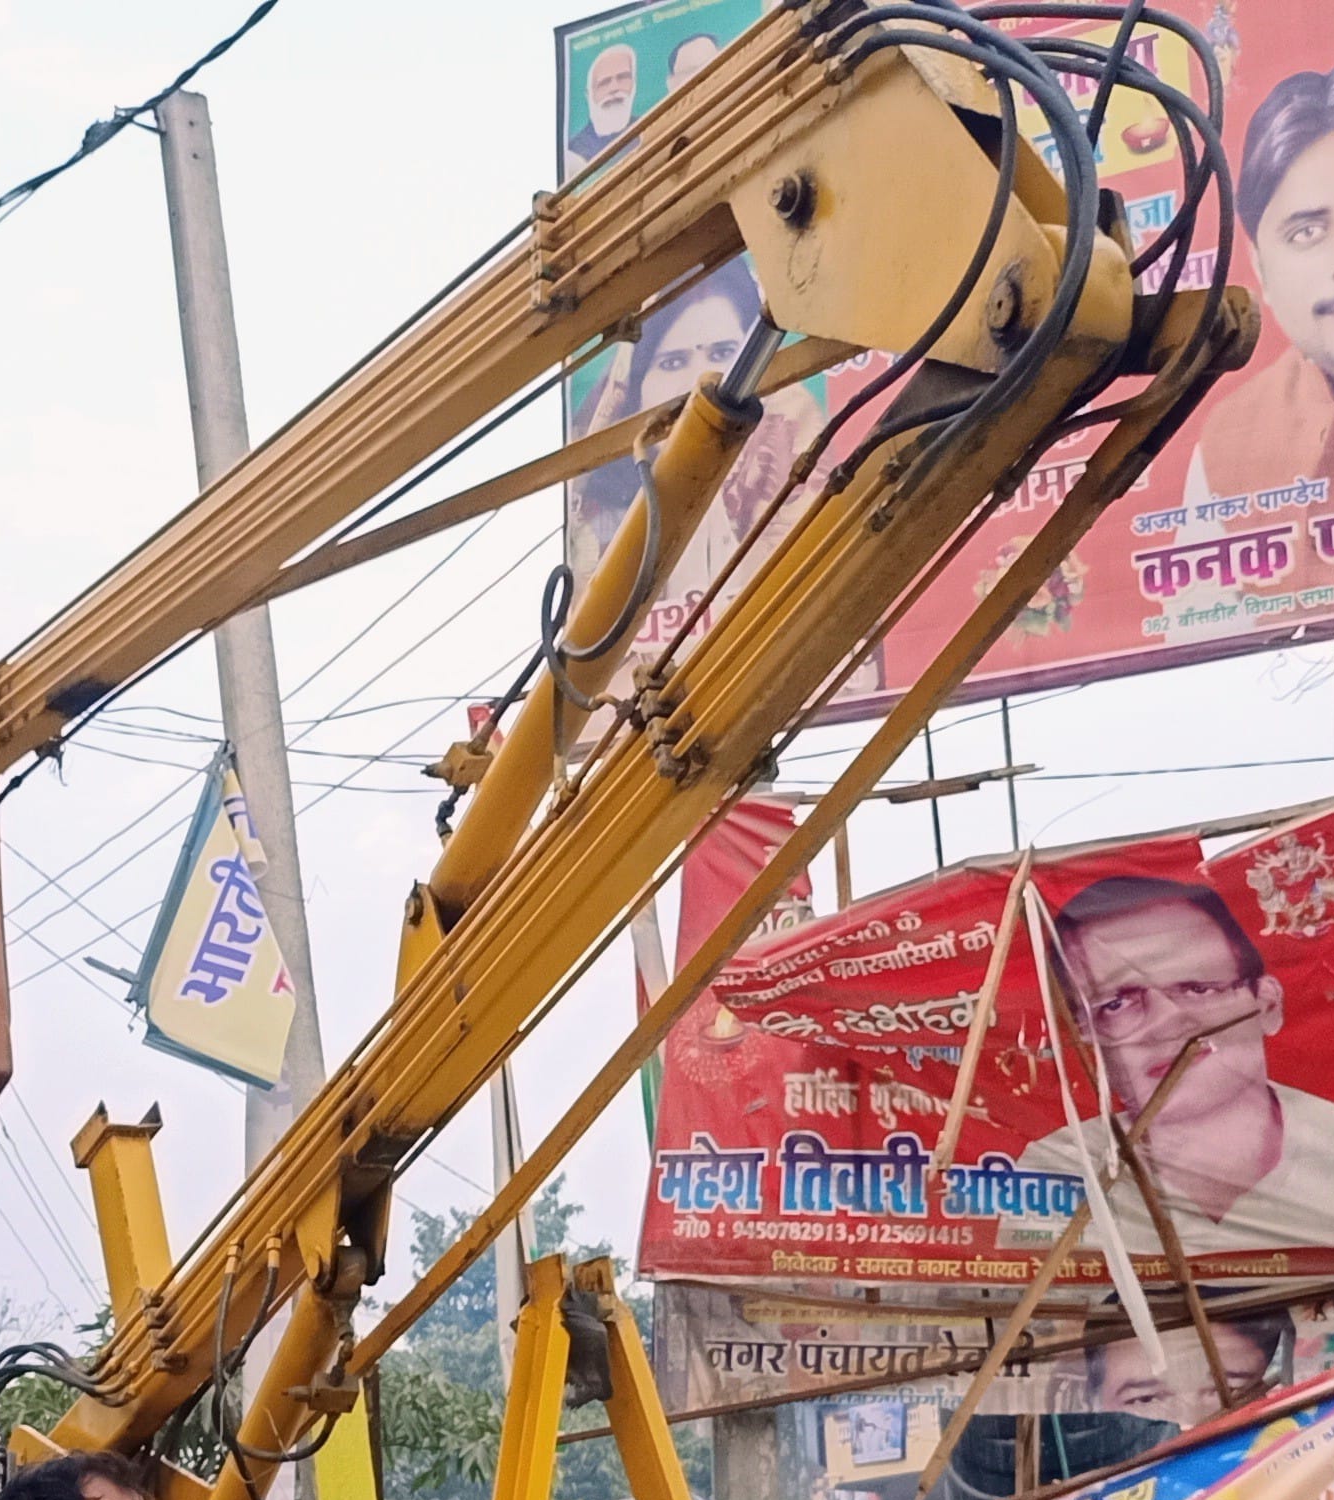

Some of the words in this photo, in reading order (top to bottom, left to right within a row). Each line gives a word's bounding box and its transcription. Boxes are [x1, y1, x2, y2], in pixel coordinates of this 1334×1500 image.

[1134, 508, 1187, 535] अजय
[1196, 496, 1248, 522] शंकर
[1258, 480, 1327, 509] पाण्डेय
[1136, 526, 1292, 597] कनक
[826, 931, 957, 979] नगरवासियों
[960, 921, 998, 951] को
[783, 1067, 860, 1118] हार्दिक
[659, 1136, 765, 1212] महेश
[780, 1133, 930, 1213] तिवारी
[944, 1155, 1087, 1217] अधिवक
[771, 1250, 838, 1273] निवेदक
[918, 1259, 962, 1277] नगर
[965, 1254, 1027, 1278] पंचायत
[1031, 1256, 1076, 1278] रेती
[706, 1340, 788, 1374] नगर
[798, 1329, 929, 1376] पंचायत
